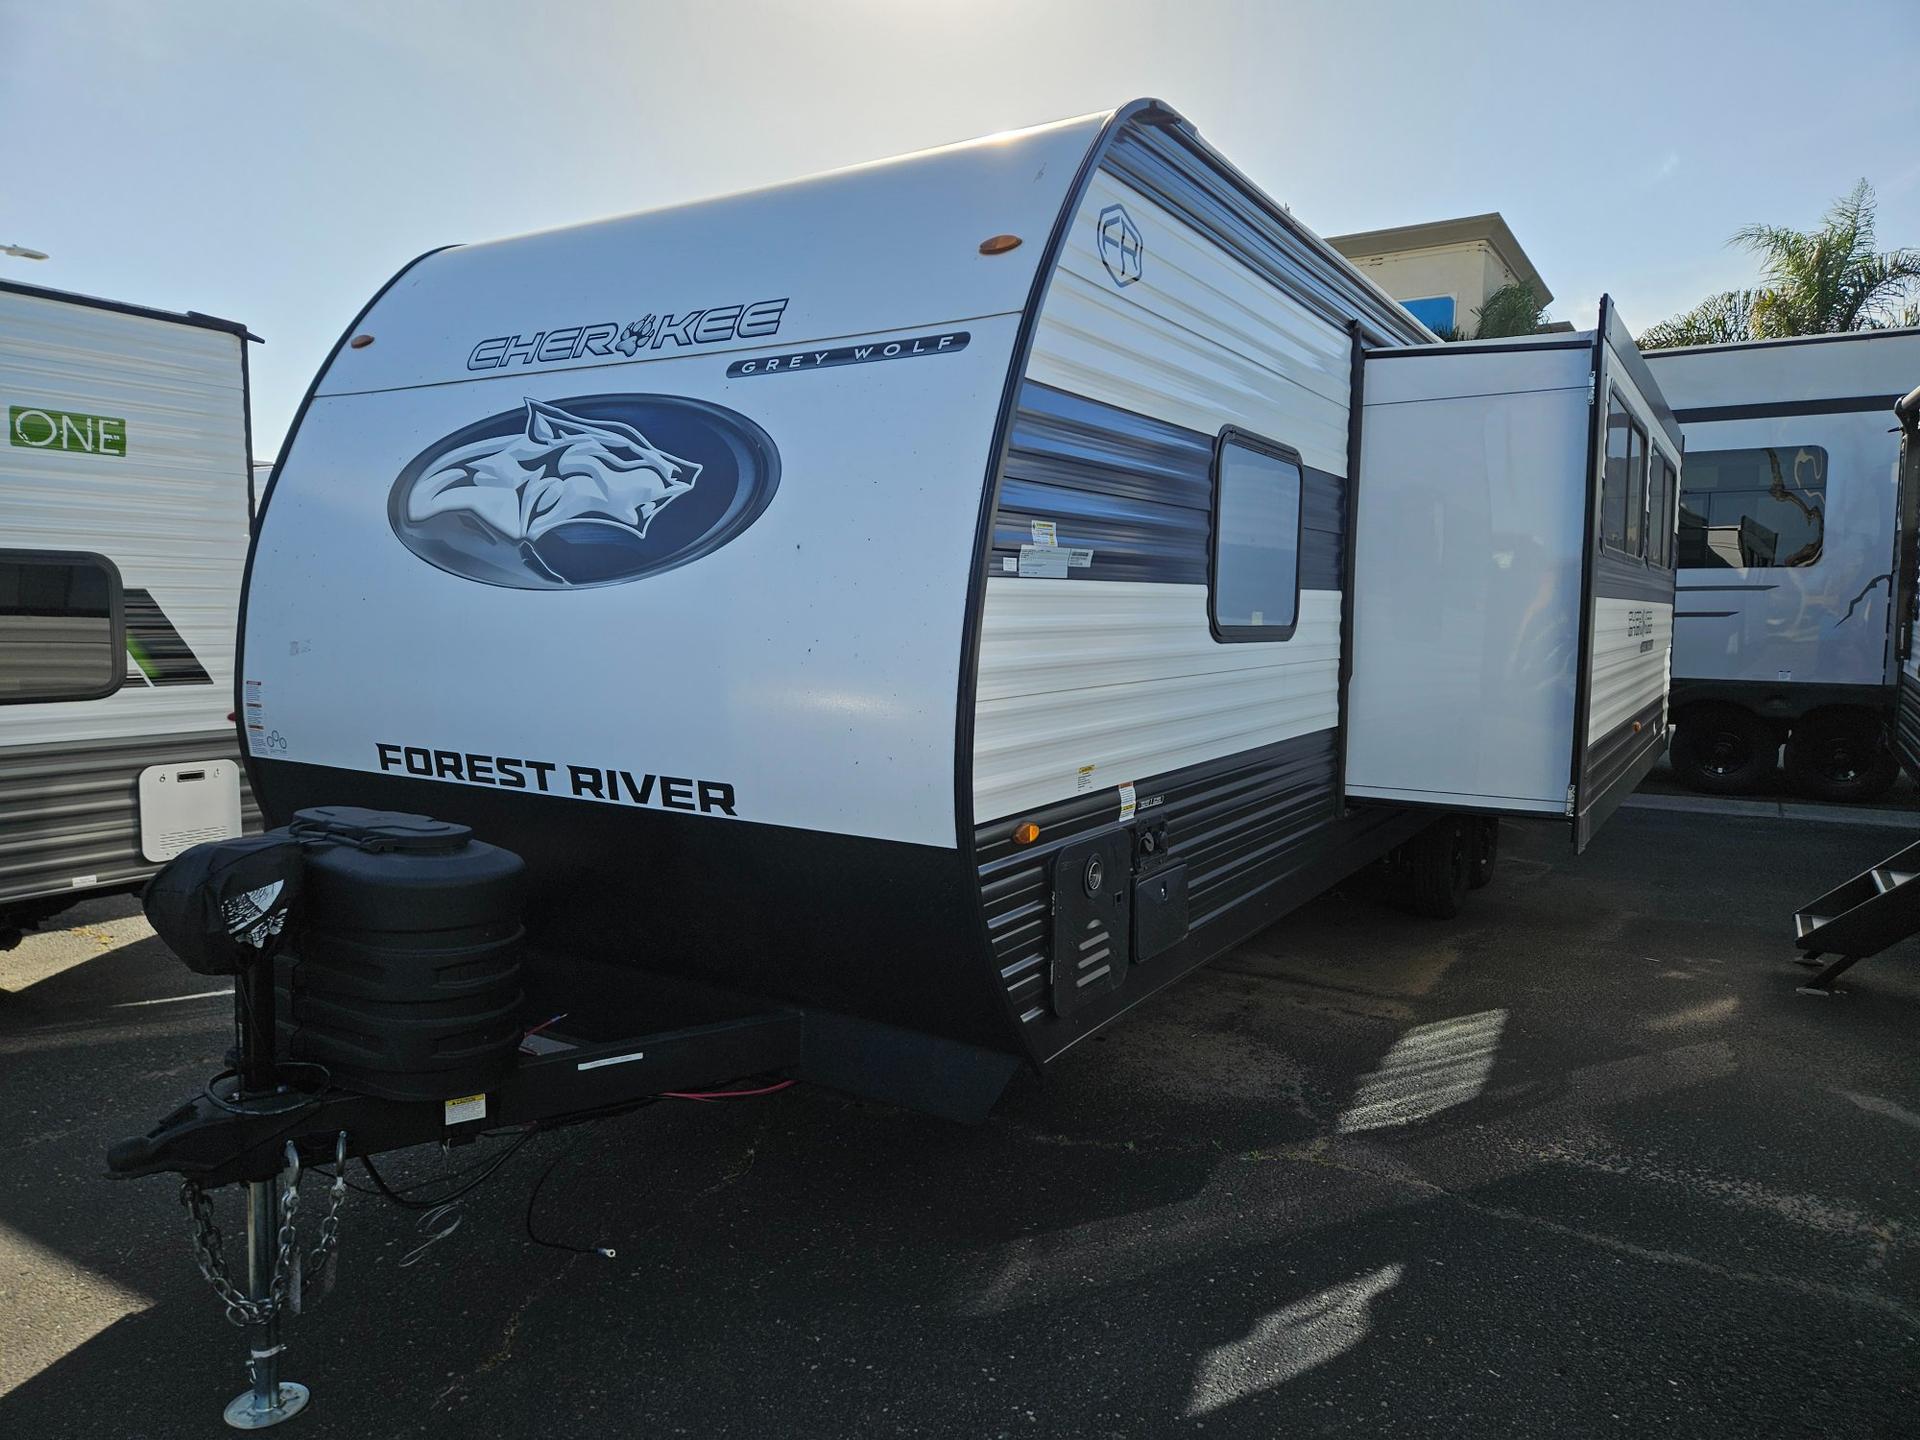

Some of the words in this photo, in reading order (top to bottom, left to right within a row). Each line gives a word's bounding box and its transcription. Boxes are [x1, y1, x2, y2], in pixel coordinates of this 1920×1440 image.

[741, 352, 828, 374] GREY
[853, 338, 954, 360] WOLF
[15, 409, 120, 454] ONE
[375, 743, 556, 791] FOREST
[566, 765, 738, 816] RIVER
